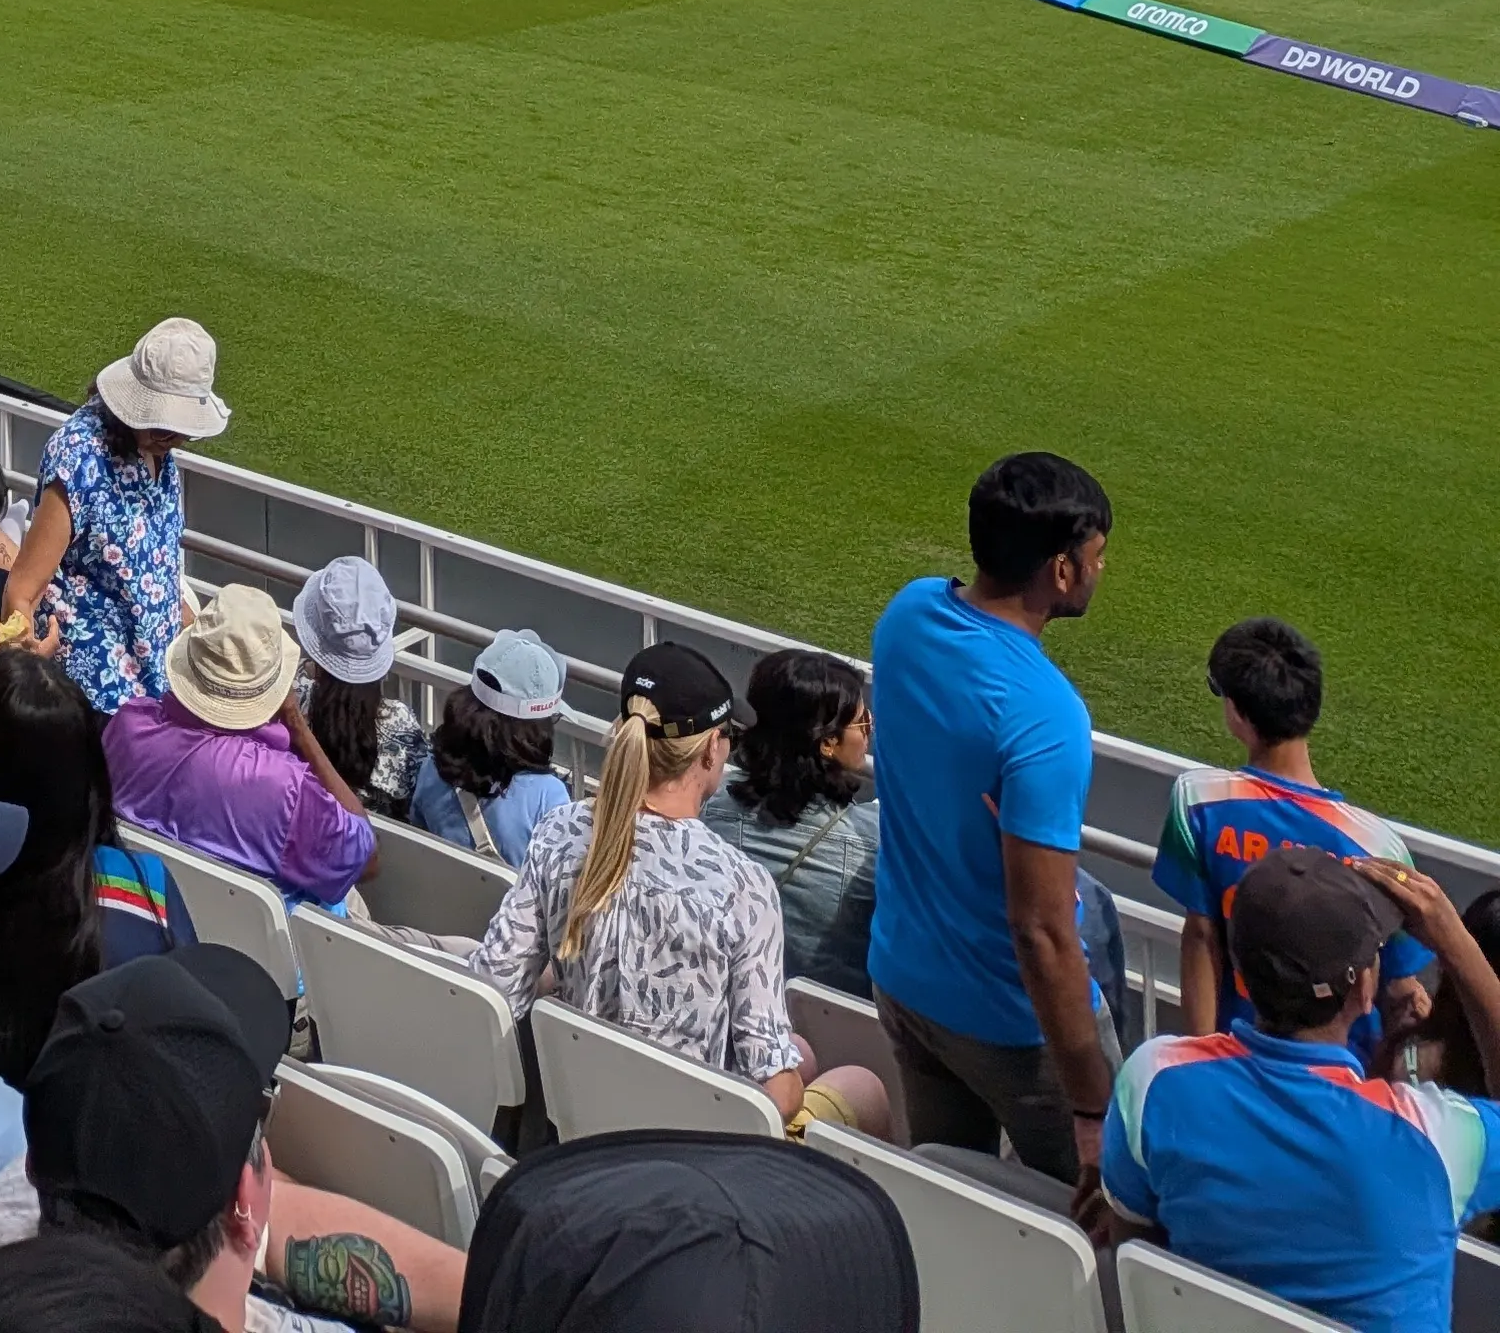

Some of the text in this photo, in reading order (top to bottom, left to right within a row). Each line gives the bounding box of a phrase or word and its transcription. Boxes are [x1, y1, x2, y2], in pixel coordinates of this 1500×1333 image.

[1127, 2, 1208, 35] aramco
[1281, 46, 1420, 100] DP WORLD
[531, 702, 553, 712] HELLO
